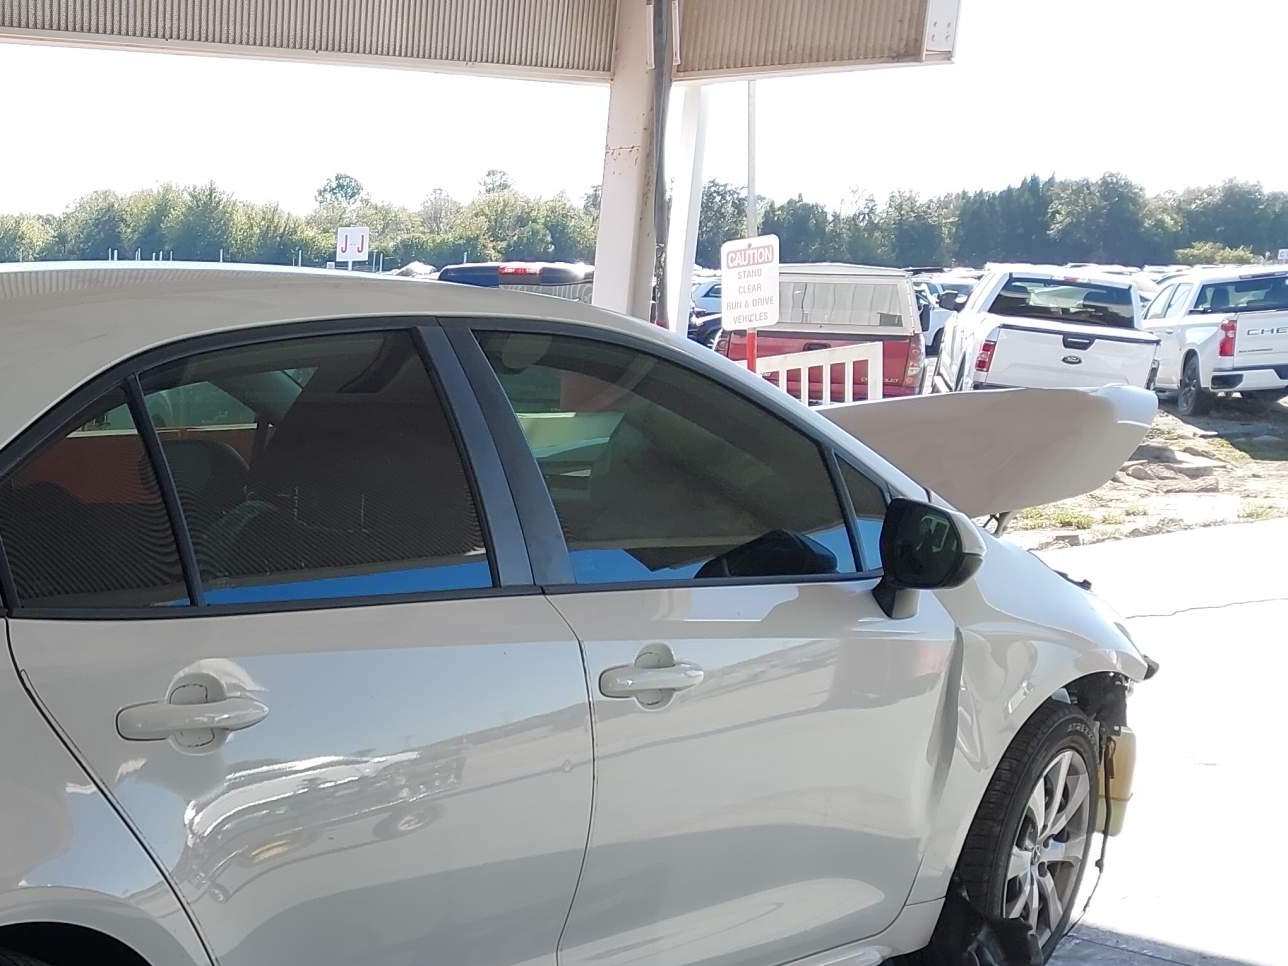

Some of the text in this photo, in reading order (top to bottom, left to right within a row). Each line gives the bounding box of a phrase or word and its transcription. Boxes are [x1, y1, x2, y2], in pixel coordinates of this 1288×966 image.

[727, 246, 773, 267] CAUTION
[737, 268, 762, 280] STAND
[738, 283, 762, 295] CLEAR
[726, 300, 743, 312] RUN
[752, 295, 775, 308] DRIVE
[733, 312, 769, 325] VEHICLES
